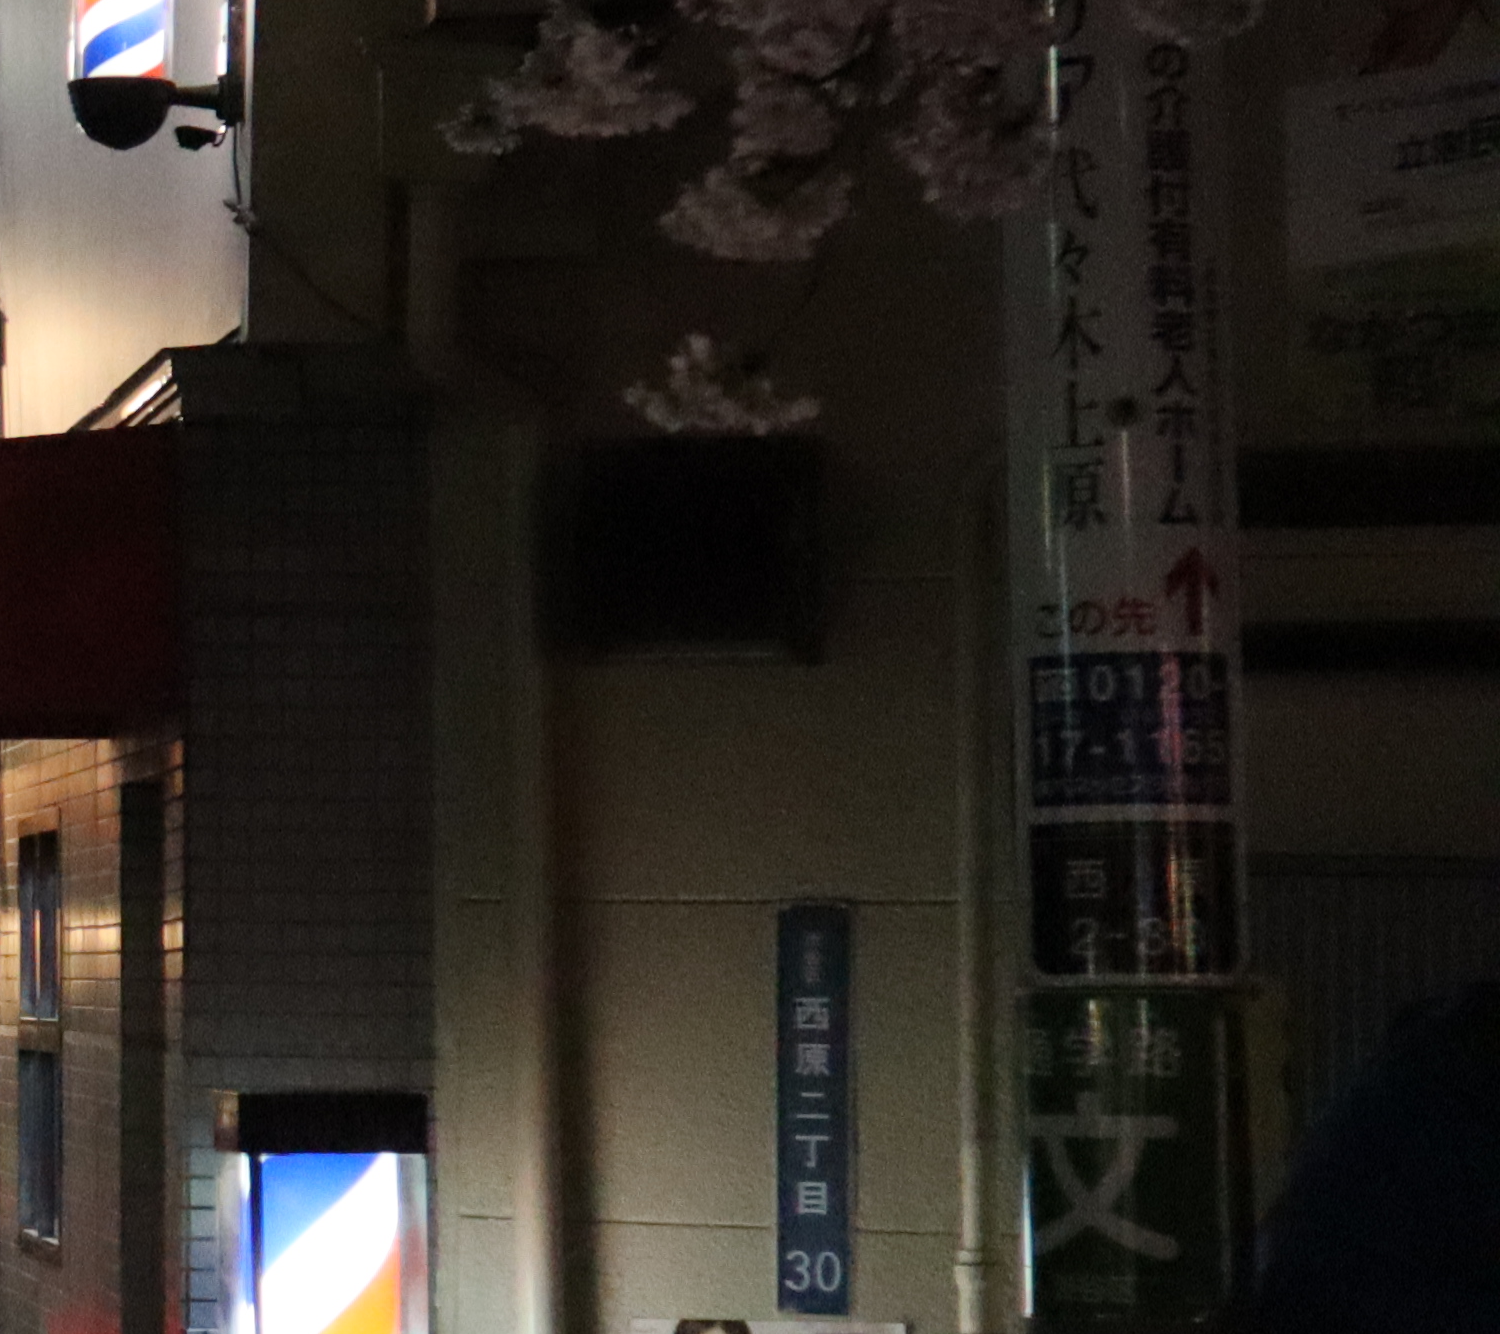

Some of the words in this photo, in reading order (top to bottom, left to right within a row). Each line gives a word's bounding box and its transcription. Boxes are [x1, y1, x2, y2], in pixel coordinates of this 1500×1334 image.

[1037, 601, 1156, 637] この先
[792, 996, 831, 1217] 西原二丁目
[1027, 1093, 1179, 1261] 文
[784, 1250, 842, 1292] 30
